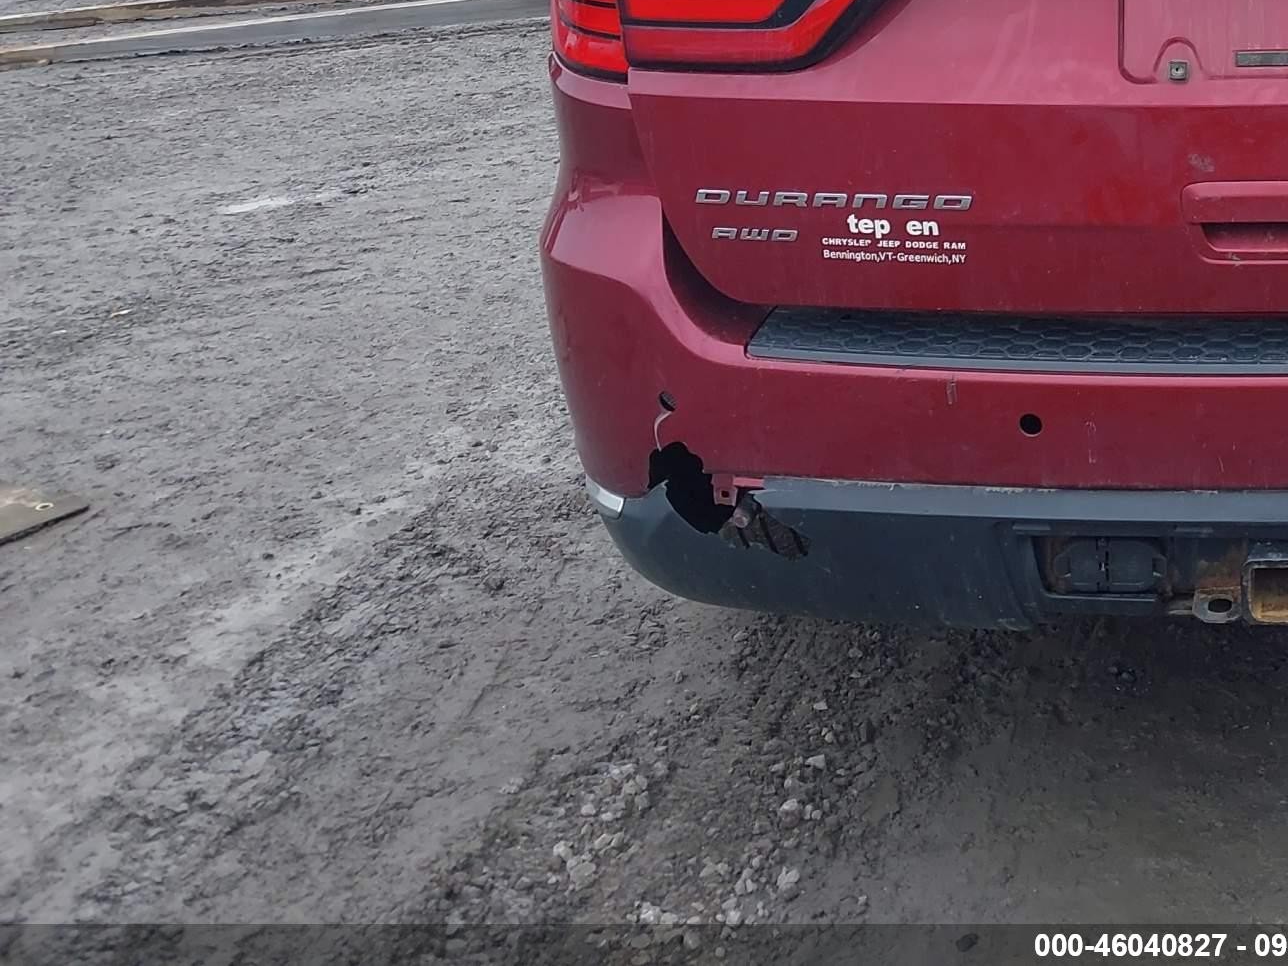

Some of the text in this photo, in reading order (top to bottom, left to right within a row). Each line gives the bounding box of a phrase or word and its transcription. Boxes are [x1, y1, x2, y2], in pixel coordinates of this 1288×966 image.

[695, 188, 972, 211] DURANGO
[712, 227, 798, 242] AWD
[877, 240, 900, 248] JEEP
[905, 241, 939, 249] DODGE
[943, 241, 966, 250] RAM
